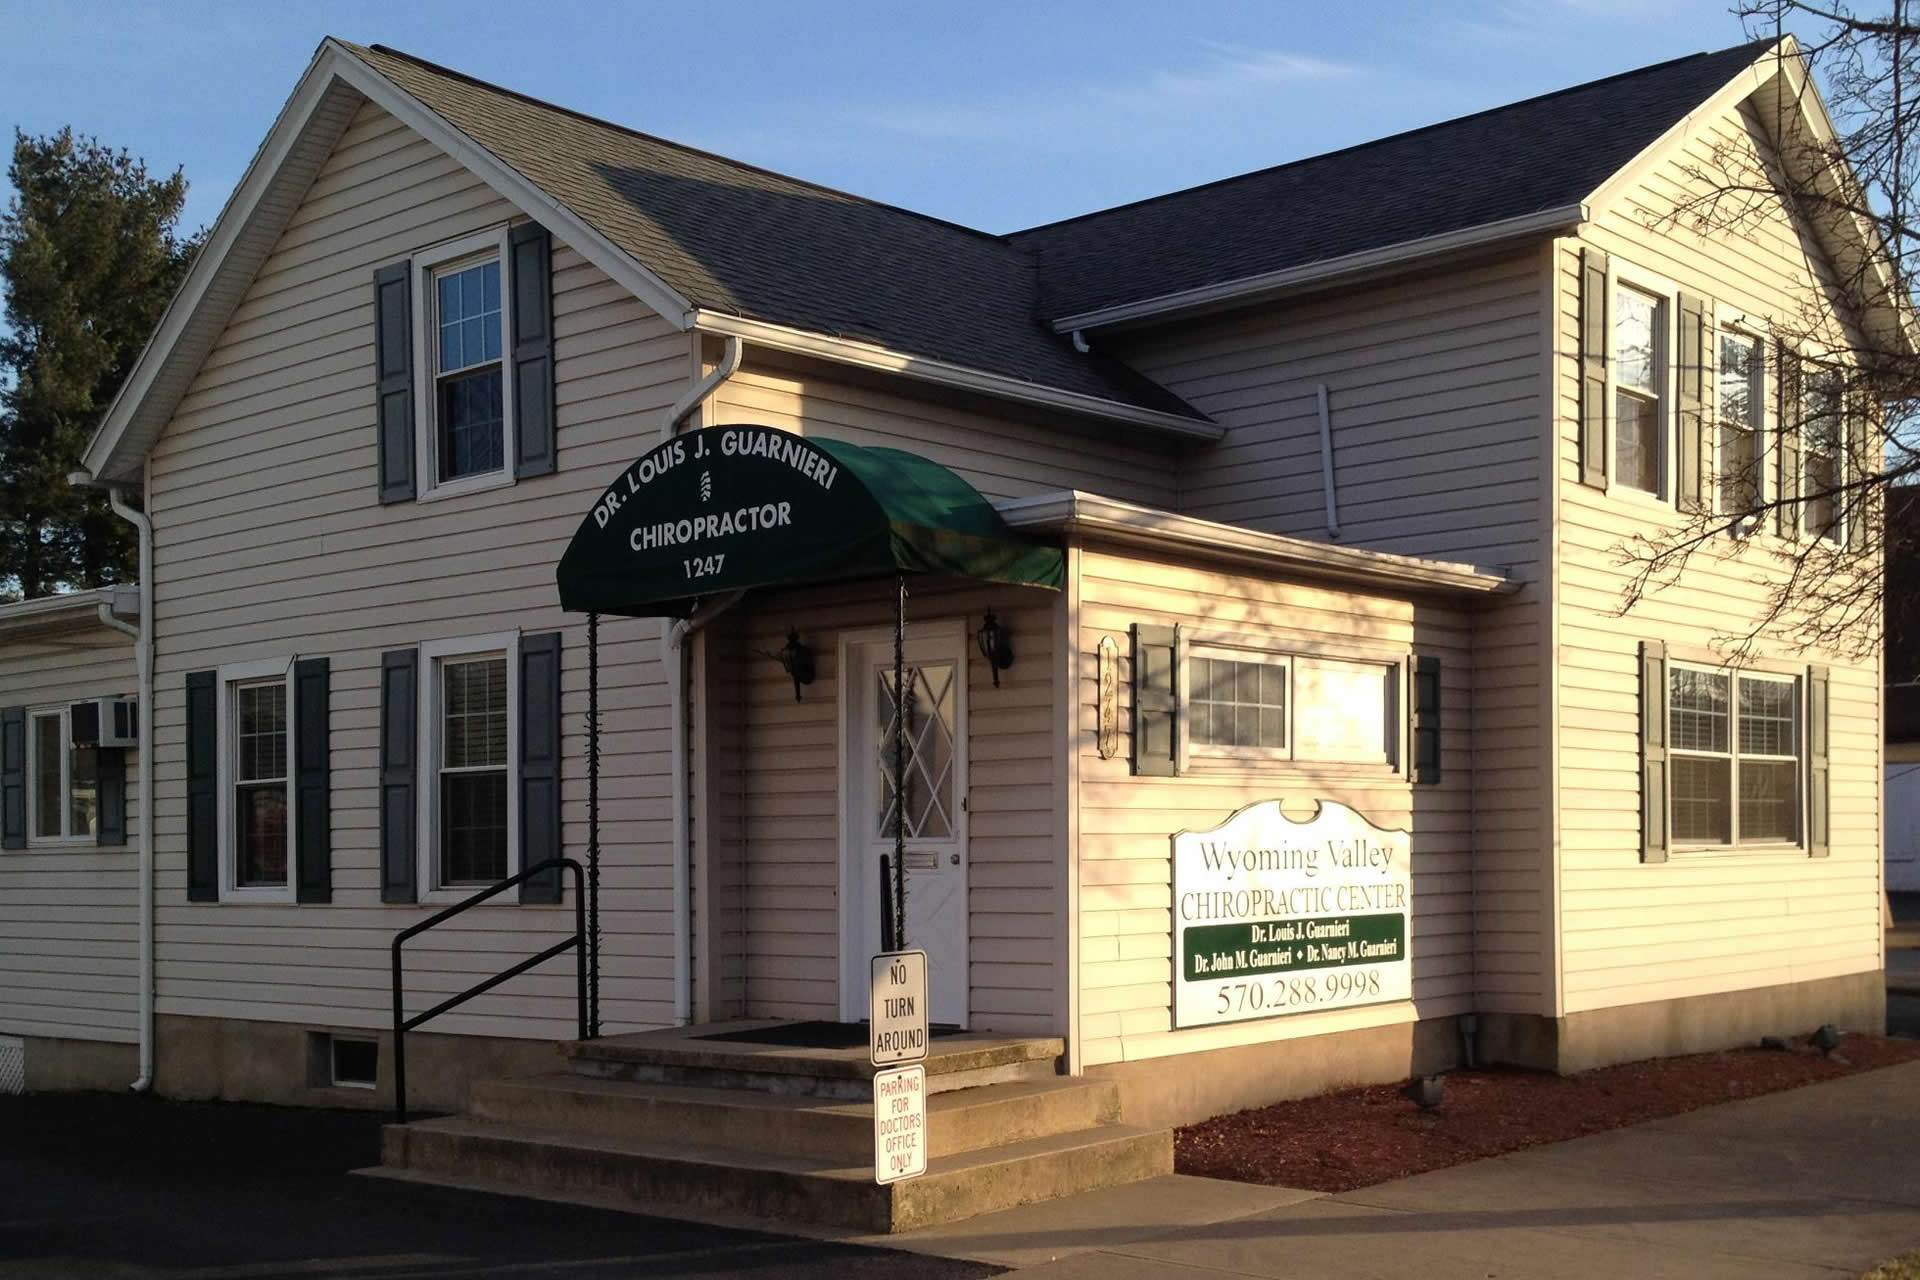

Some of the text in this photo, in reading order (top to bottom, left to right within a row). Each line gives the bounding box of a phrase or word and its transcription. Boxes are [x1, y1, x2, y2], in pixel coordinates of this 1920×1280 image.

[594, 430, 838, 529] DR. LOUIS J. GUARNIERI
[629, 501, 792, 552] CHIROPRACTOR
[683, 554, 726, 579] 1247
[1200, 839, 1394, 880] Wyoming Valley
[1181, 883, 1406, 921] CHIROPRACTIC CENTER
[1251, 919, 1350, 943] Dr. Louis J. Guarnieri
[1195, 938, 1397, 973] Dr. John M. Guarnieri Dr. Nancy M. Guarnieri
[890, 964, 907, 985] NO
[1217, 969, 1380, 1015] 570.288.9998
[884, 996, 915, 1019] TURN
[876, 1028, 924, 1053] AROUND
[880, 1076, 920, 1098] PARKING
[891, 1097, 909, 1114] FOR
[880, 1118, 922, 1136] DOCTORS
[885, 1132, 917, 1153] OFFICE
[890, 1153, 913, 1171] ONLY
